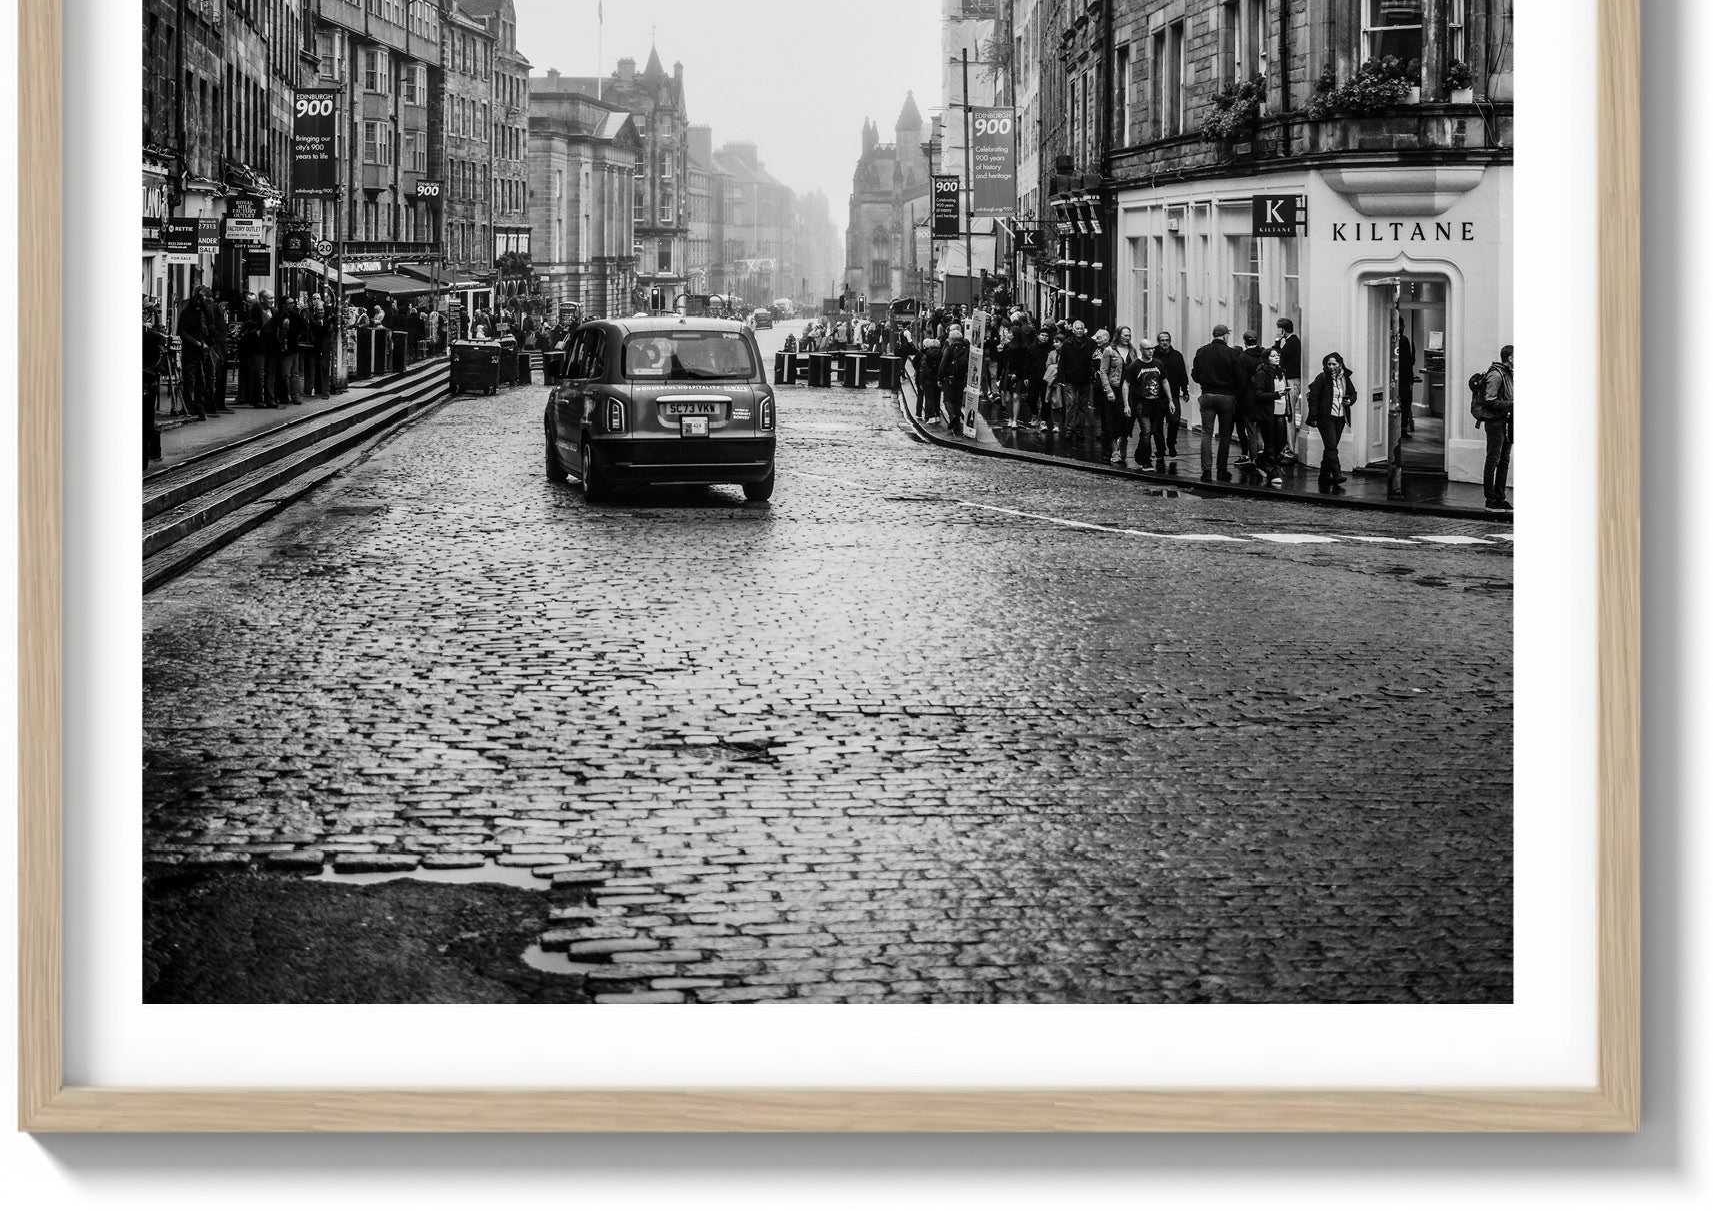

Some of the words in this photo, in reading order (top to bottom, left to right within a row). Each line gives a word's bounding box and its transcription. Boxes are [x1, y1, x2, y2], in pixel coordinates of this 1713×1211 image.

[296, 100, 333, 118] 900
[975, 118, 1011, 136] 900
[296, 135, 319, 143] Bringing
[417, 186, 439, 196] 900
[936, 182, 958, 193] 900
[1266, 200, 1284, 223] K
[1333, 222, 1474, 241] KILTANE
[1024, 232, 1034, 244] K
[670, 404, 695, 413] SC73
[698, 404, 715, 413] VKW
